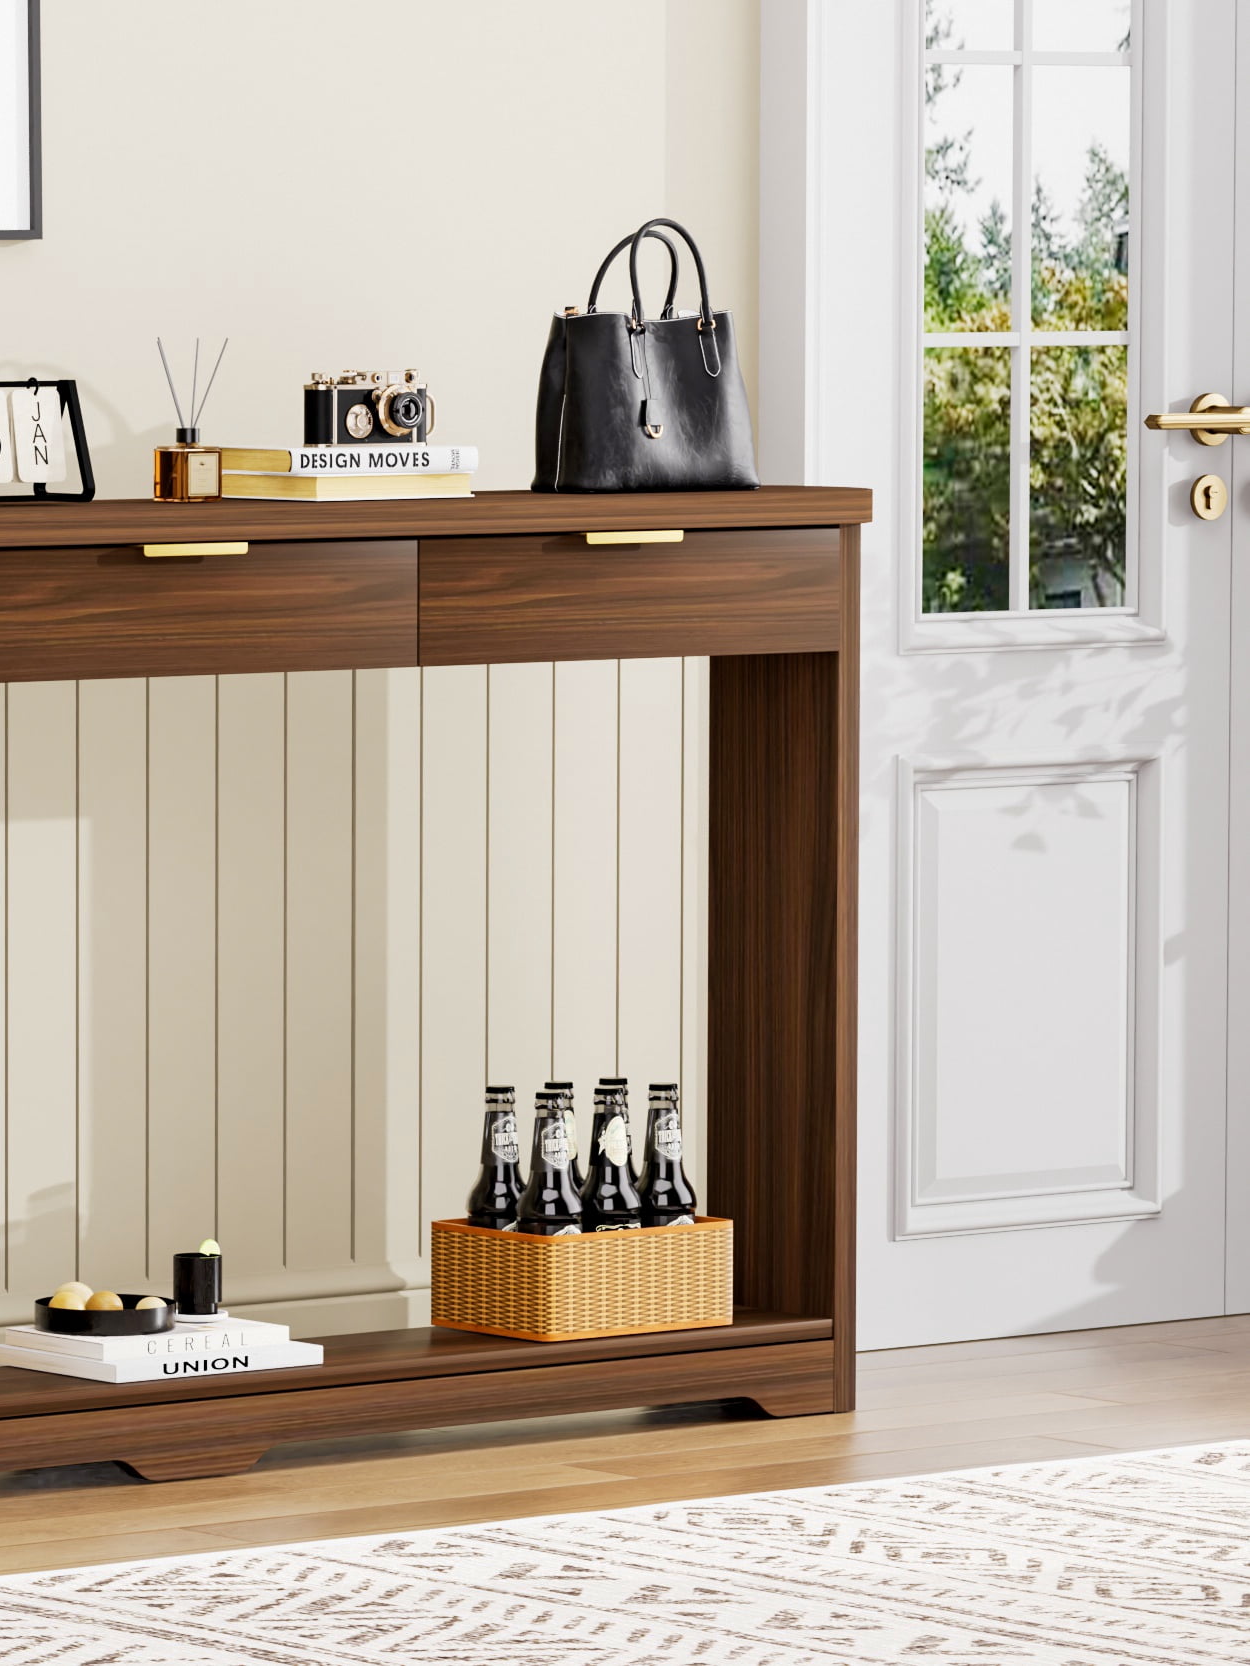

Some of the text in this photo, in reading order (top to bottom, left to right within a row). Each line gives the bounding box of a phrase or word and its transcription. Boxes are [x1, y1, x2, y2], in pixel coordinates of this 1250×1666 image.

[31, 401, 49, 466] JAN
[300, 451, 430, 469] DESIGN MOVES
[147, 1331, 249, 1354] CEREAL
[163, 1355, 249, 1375] UNION
